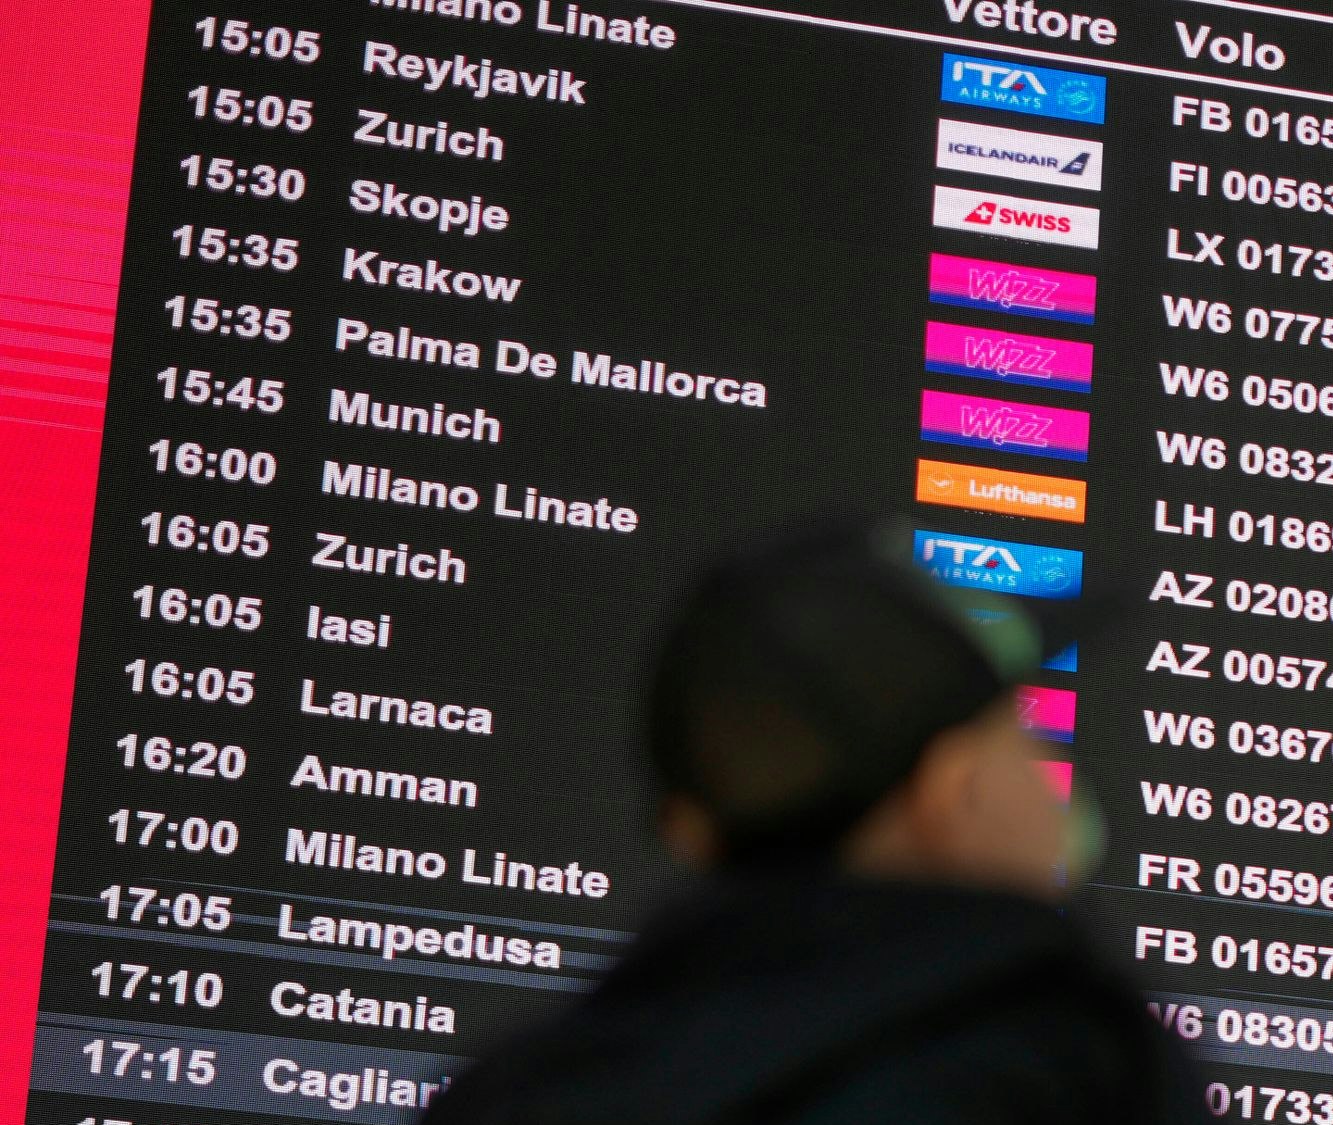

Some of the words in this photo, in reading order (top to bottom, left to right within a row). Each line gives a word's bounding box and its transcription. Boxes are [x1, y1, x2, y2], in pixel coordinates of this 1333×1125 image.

[196, 17, 319, 63] 15:05
[537, 0, 677, 50] Linate
[945, 0, 1117, 46] Vettore
[1175, 21, 1286, 72] Volo
[363, 41, 584, 105] Reykjavik
[951, 60, 1048, 96] ITA
[960, 87, 1042, 109] AIRWAYS
[1172, 95, 1232, 133] FB
[354, 109, 504, 161] Zurich
[948, 142, 1059, 168] ICELANDAIR
[181, 155, 305, 201] 15:30
[349, 179, 509, 236] Skopje
[998, 207, 1071, 233] SWISS
[343, 247, 521, 303] Krakow
[165, 295, 291, 342] 15:35
[336, 317, 480, 369] Palma
[495, 340, 557, 379] De
[571, 350, 766, 408] Mallorca
[1159, 362, 1230, 402] W6
[329, 388, 500, 443] Munich
[149, 439, 277, 485] 16:00
[322, 460, 479, 512] Milano
[494, 483, 638, 533] Linate
[968, 479, 1078, 510] Lufthansa
[311, 532, 466, 584] Zurich
[307, 605, 390, 648] Iasi
[1145, 640, 1211, 679] AZ
[300, 678, 493, 735] Larnaca
[117, 733, 247, 780] 16:20
[290, 754, 478, 808] Amman
[285, 827, 447, 879] Milano
[461, 848, 610, 899] Linate
[100, 884, 232, 931] 17:05
[278, 903, 562, 970] Lampedusa
[1135, 925, 1198, 965] FB
[270, 981, 455, 1034] Catania
[82, 1038, 216, 1086] 17:15
